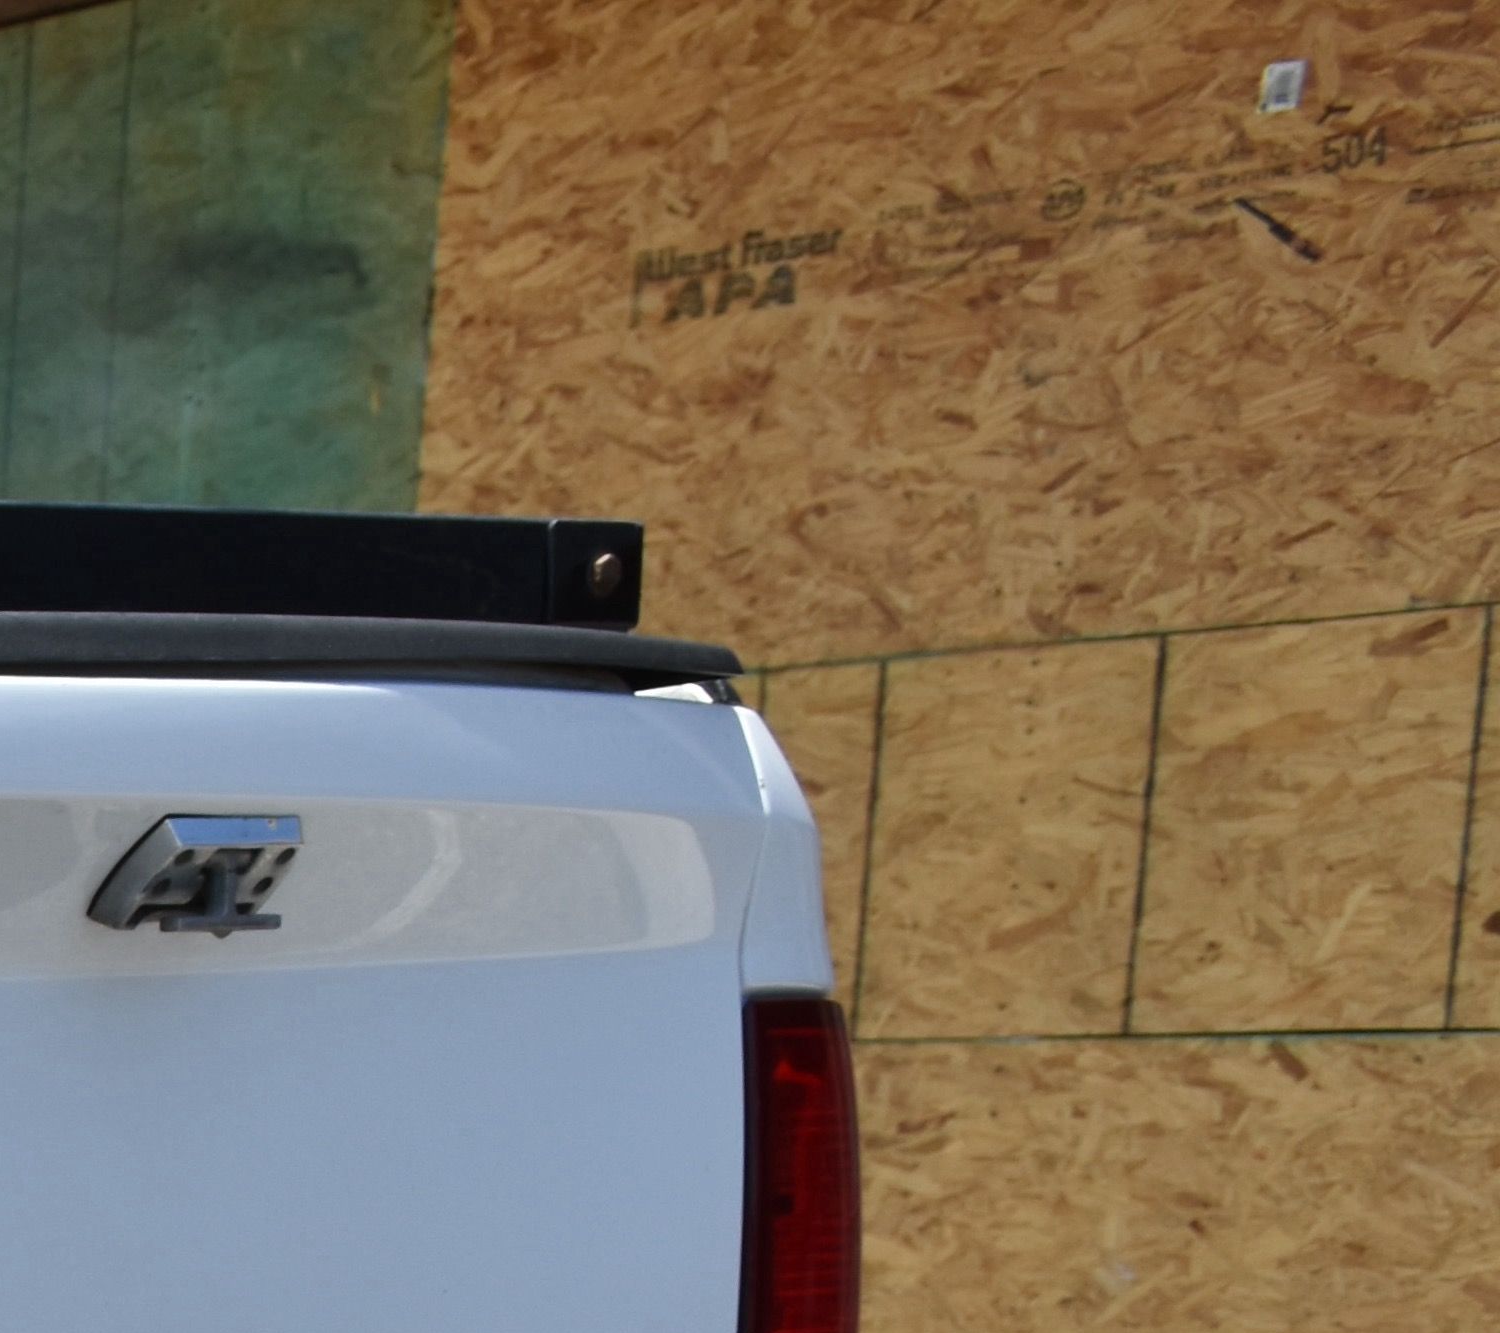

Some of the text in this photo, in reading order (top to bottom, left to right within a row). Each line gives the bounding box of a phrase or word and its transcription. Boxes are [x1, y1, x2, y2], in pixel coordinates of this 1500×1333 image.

[1320, 126, 1387, 174] 504
[741, 229, 844, 266] Fraser
[662, 264, 797, 323] APA
